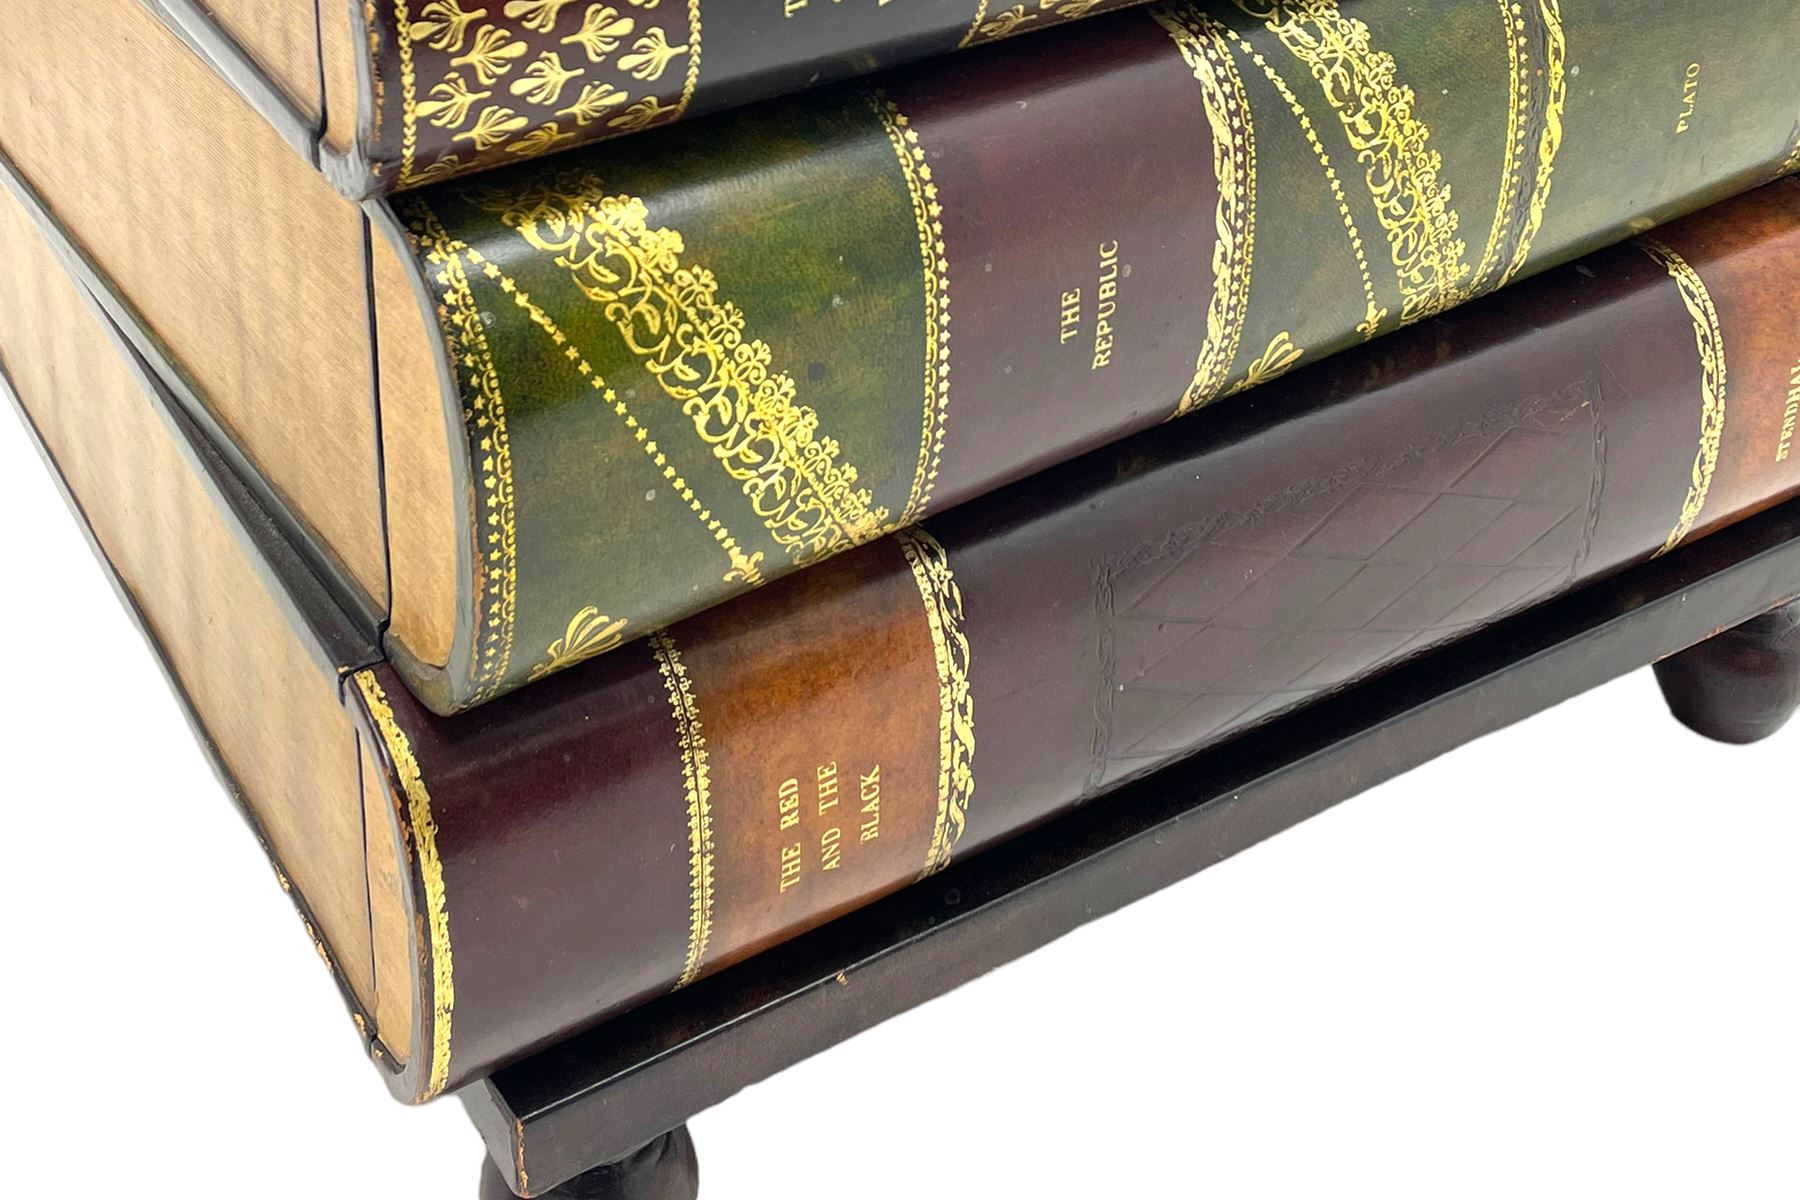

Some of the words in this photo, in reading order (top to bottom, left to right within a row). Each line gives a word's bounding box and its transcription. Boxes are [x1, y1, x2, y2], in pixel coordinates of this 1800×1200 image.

[1675, 62, 1701, 134] PLATO
[1060, 288, 1081, 344] THE
[1091, 240, 1119, 370] REPUBLIC
[778, 777, 800, 832] RED
[816, 760, 839, 817] THE
[859, 764, 881, 845] BLACK
[779, 842, 801, 894] THE
[821, 827, 842, 871] AND
